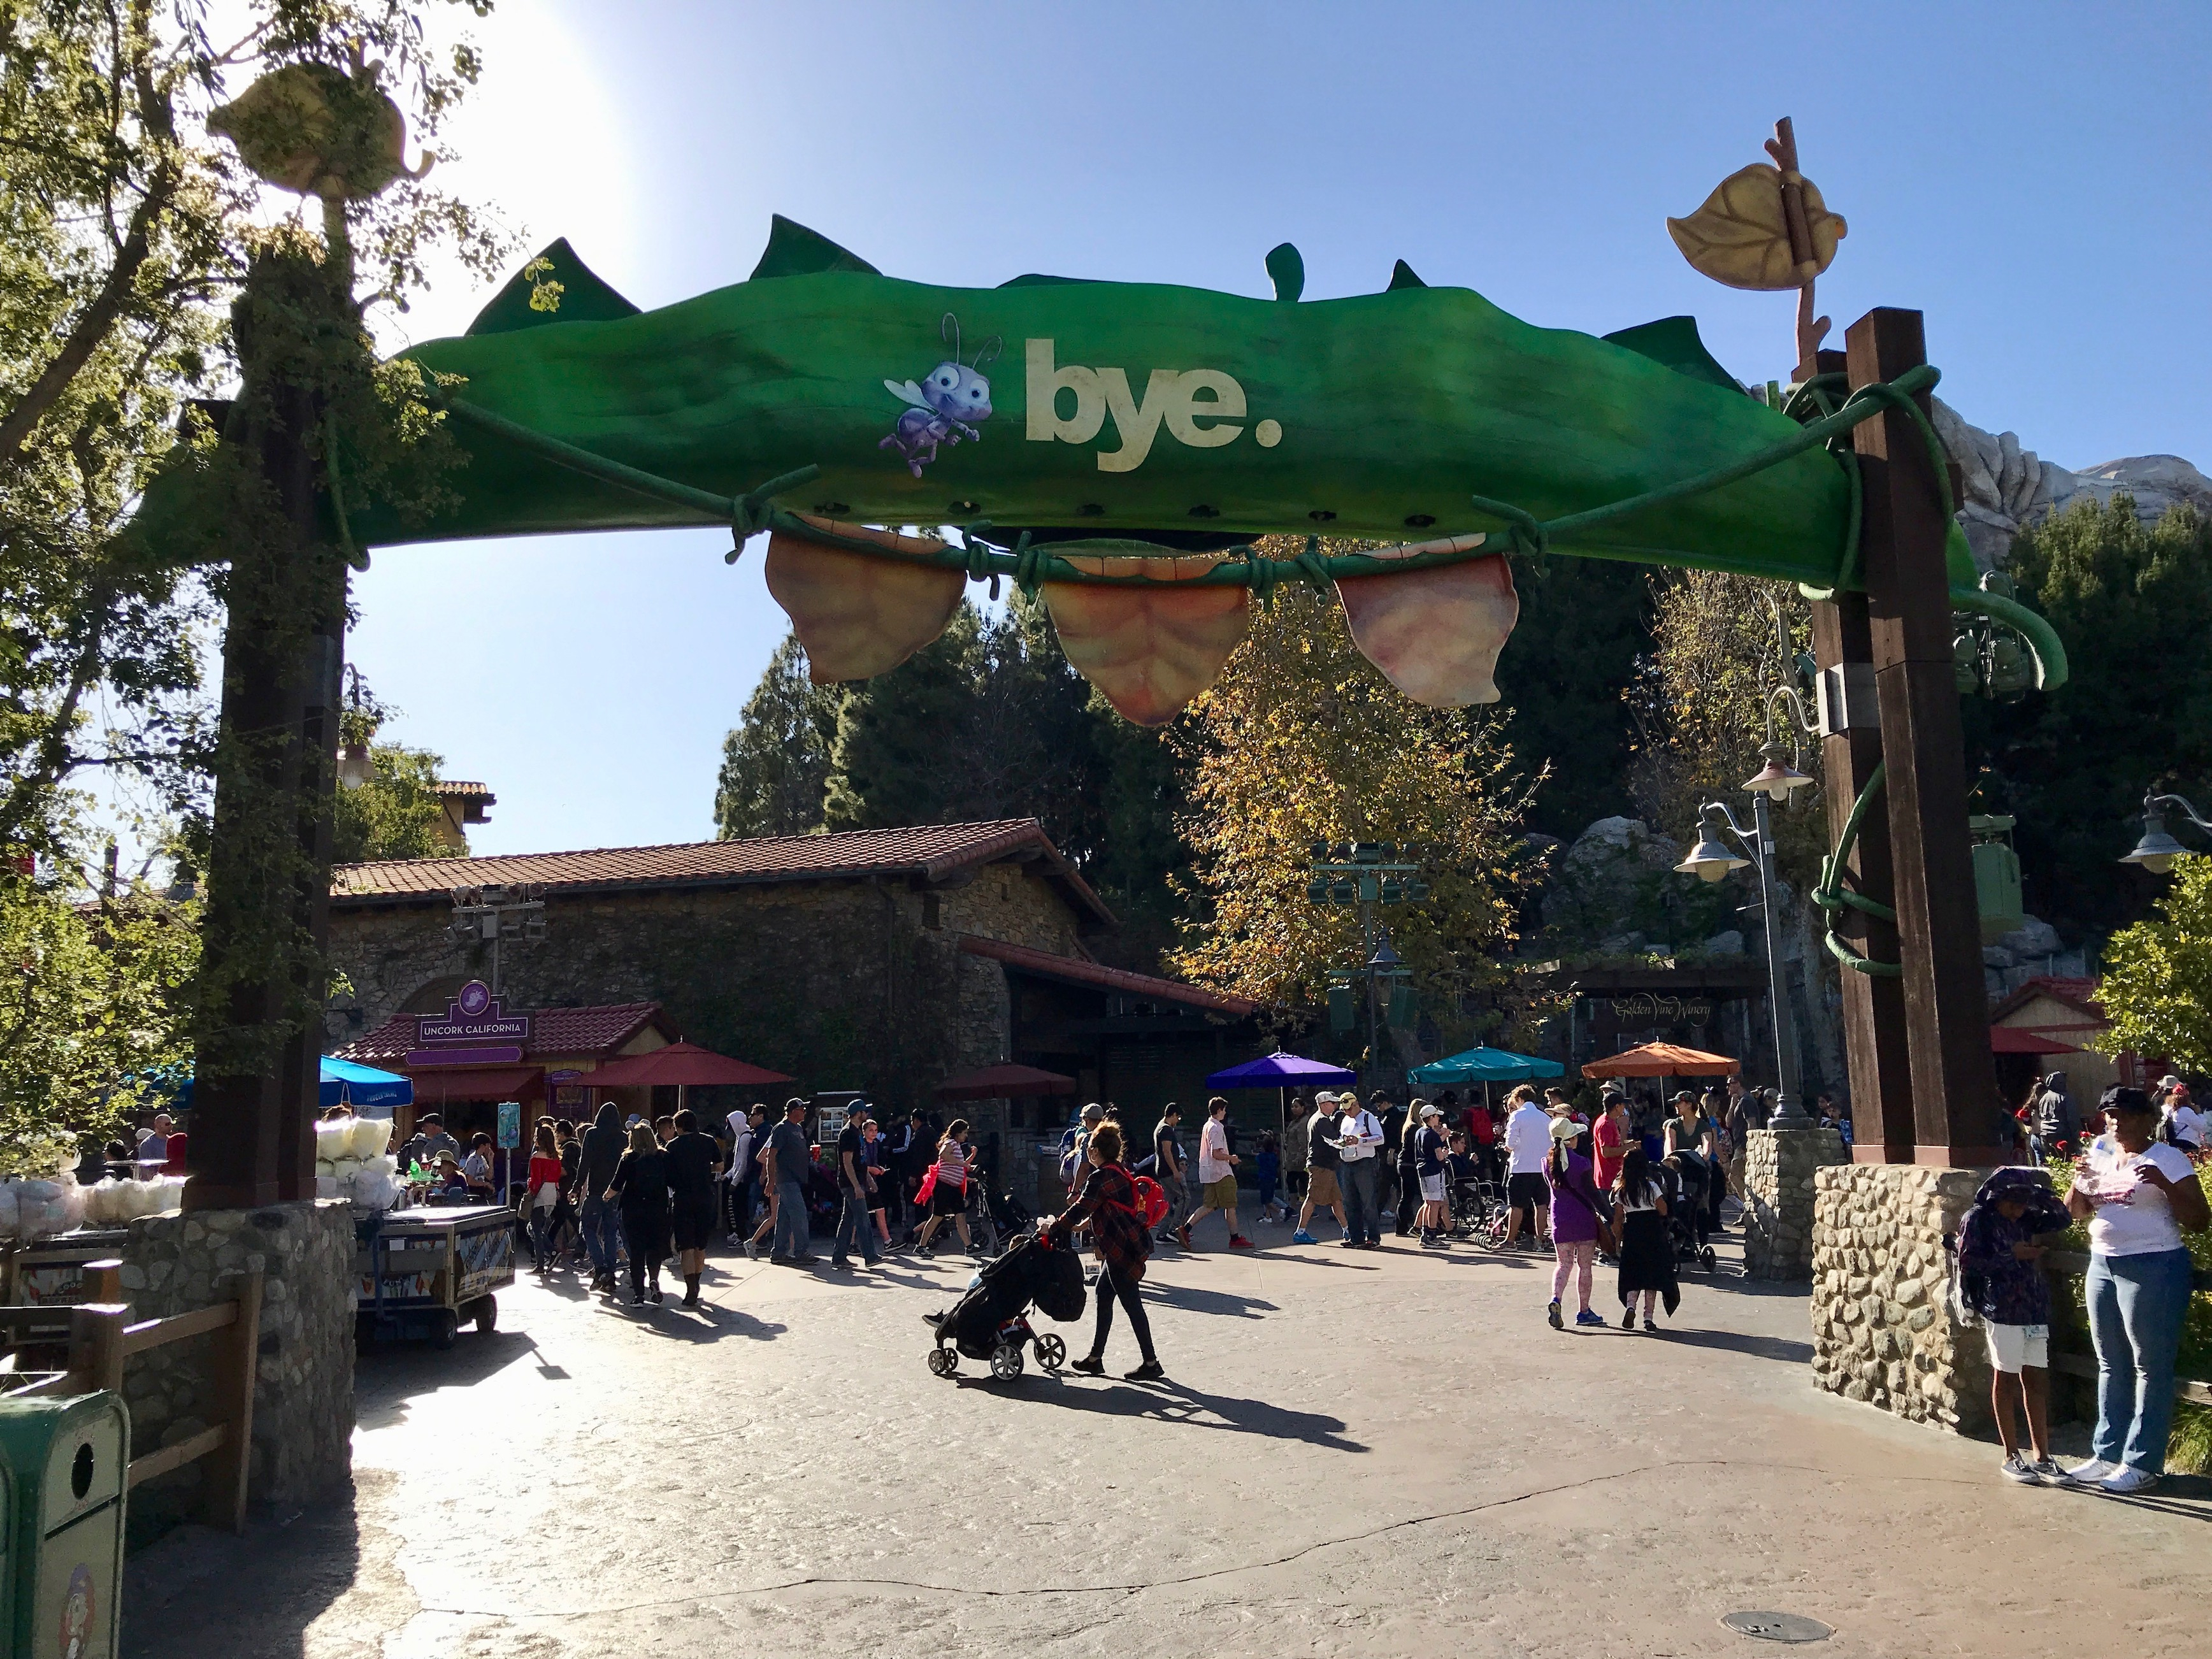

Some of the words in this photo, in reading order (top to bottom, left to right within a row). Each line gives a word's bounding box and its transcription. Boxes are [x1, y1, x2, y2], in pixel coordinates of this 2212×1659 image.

[1026, 338, 1282, 473] bye.
[1612, 1000, 1651, 1023] Golden
[1673, 997, 1711, 1027] Winery
[424, 1026, 463, 1035] UNCORK
[465, 1023, 521, 1034] CALIFORNIA
[728, 1195, 737, 1228] HOLLISTER
